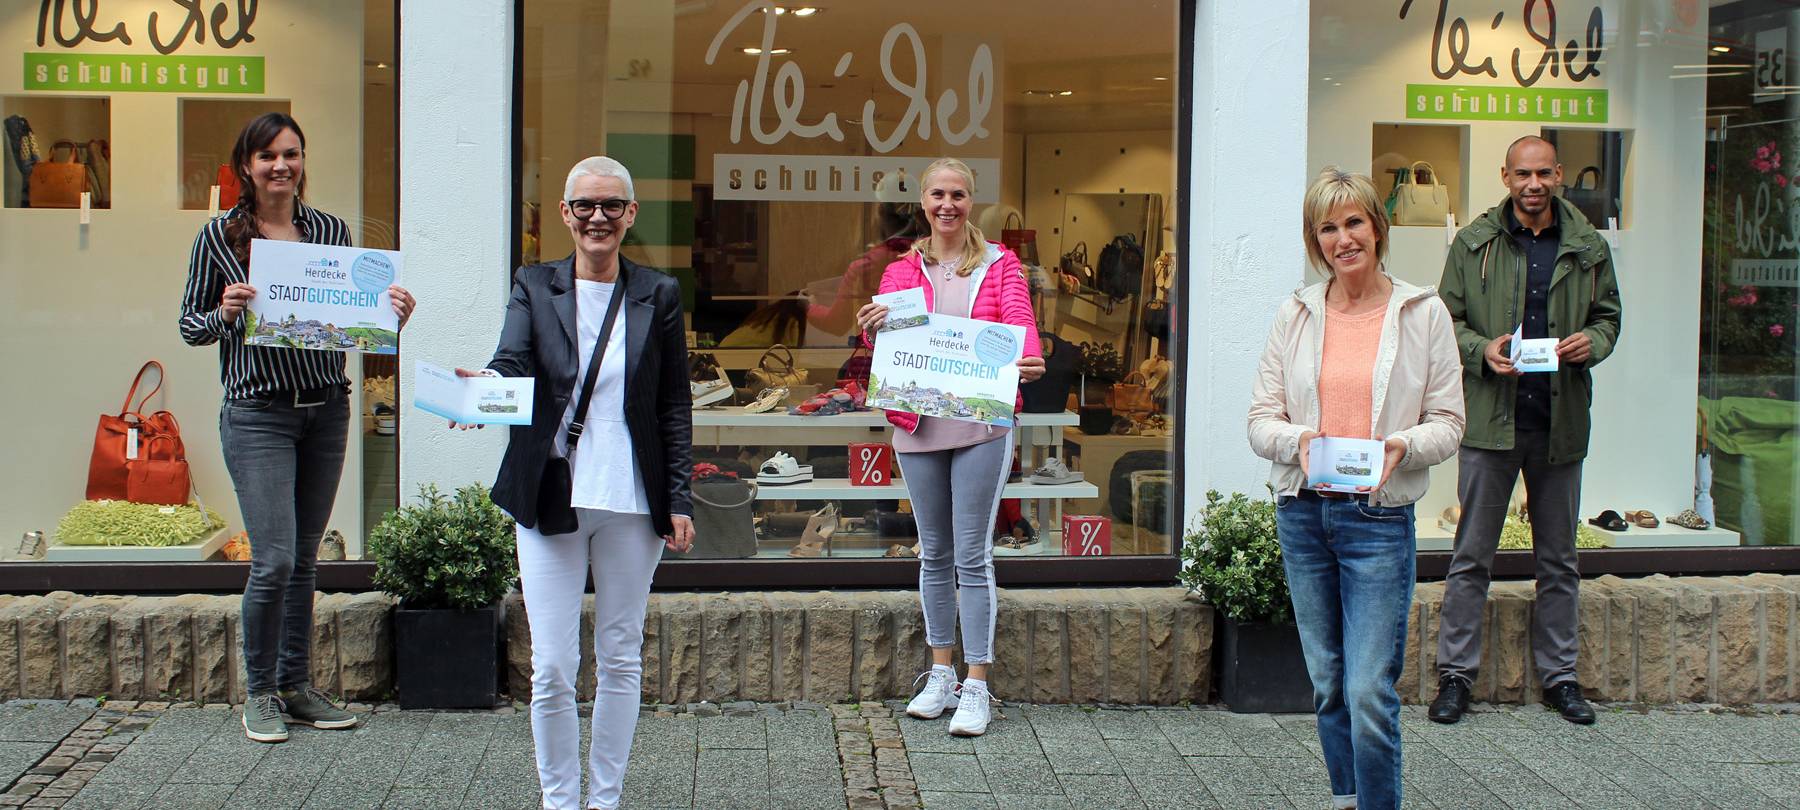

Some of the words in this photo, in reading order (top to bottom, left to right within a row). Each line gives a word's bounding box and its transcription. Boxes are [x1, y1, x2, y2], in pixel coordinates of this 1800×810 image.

[36, 62, 248, 88] schuhistgut
[1416, 93, 1595, 118] schuhistgut
[305, 267, 347, 280] Herdecke
[269, 284, 379, 308] STADTGUTSCHEIN
[929, 337, 970, 351] Herdecke
[892, 350, 1000, 381] STADTGUTSCHEIN
[860, 447, 883, 484] %
